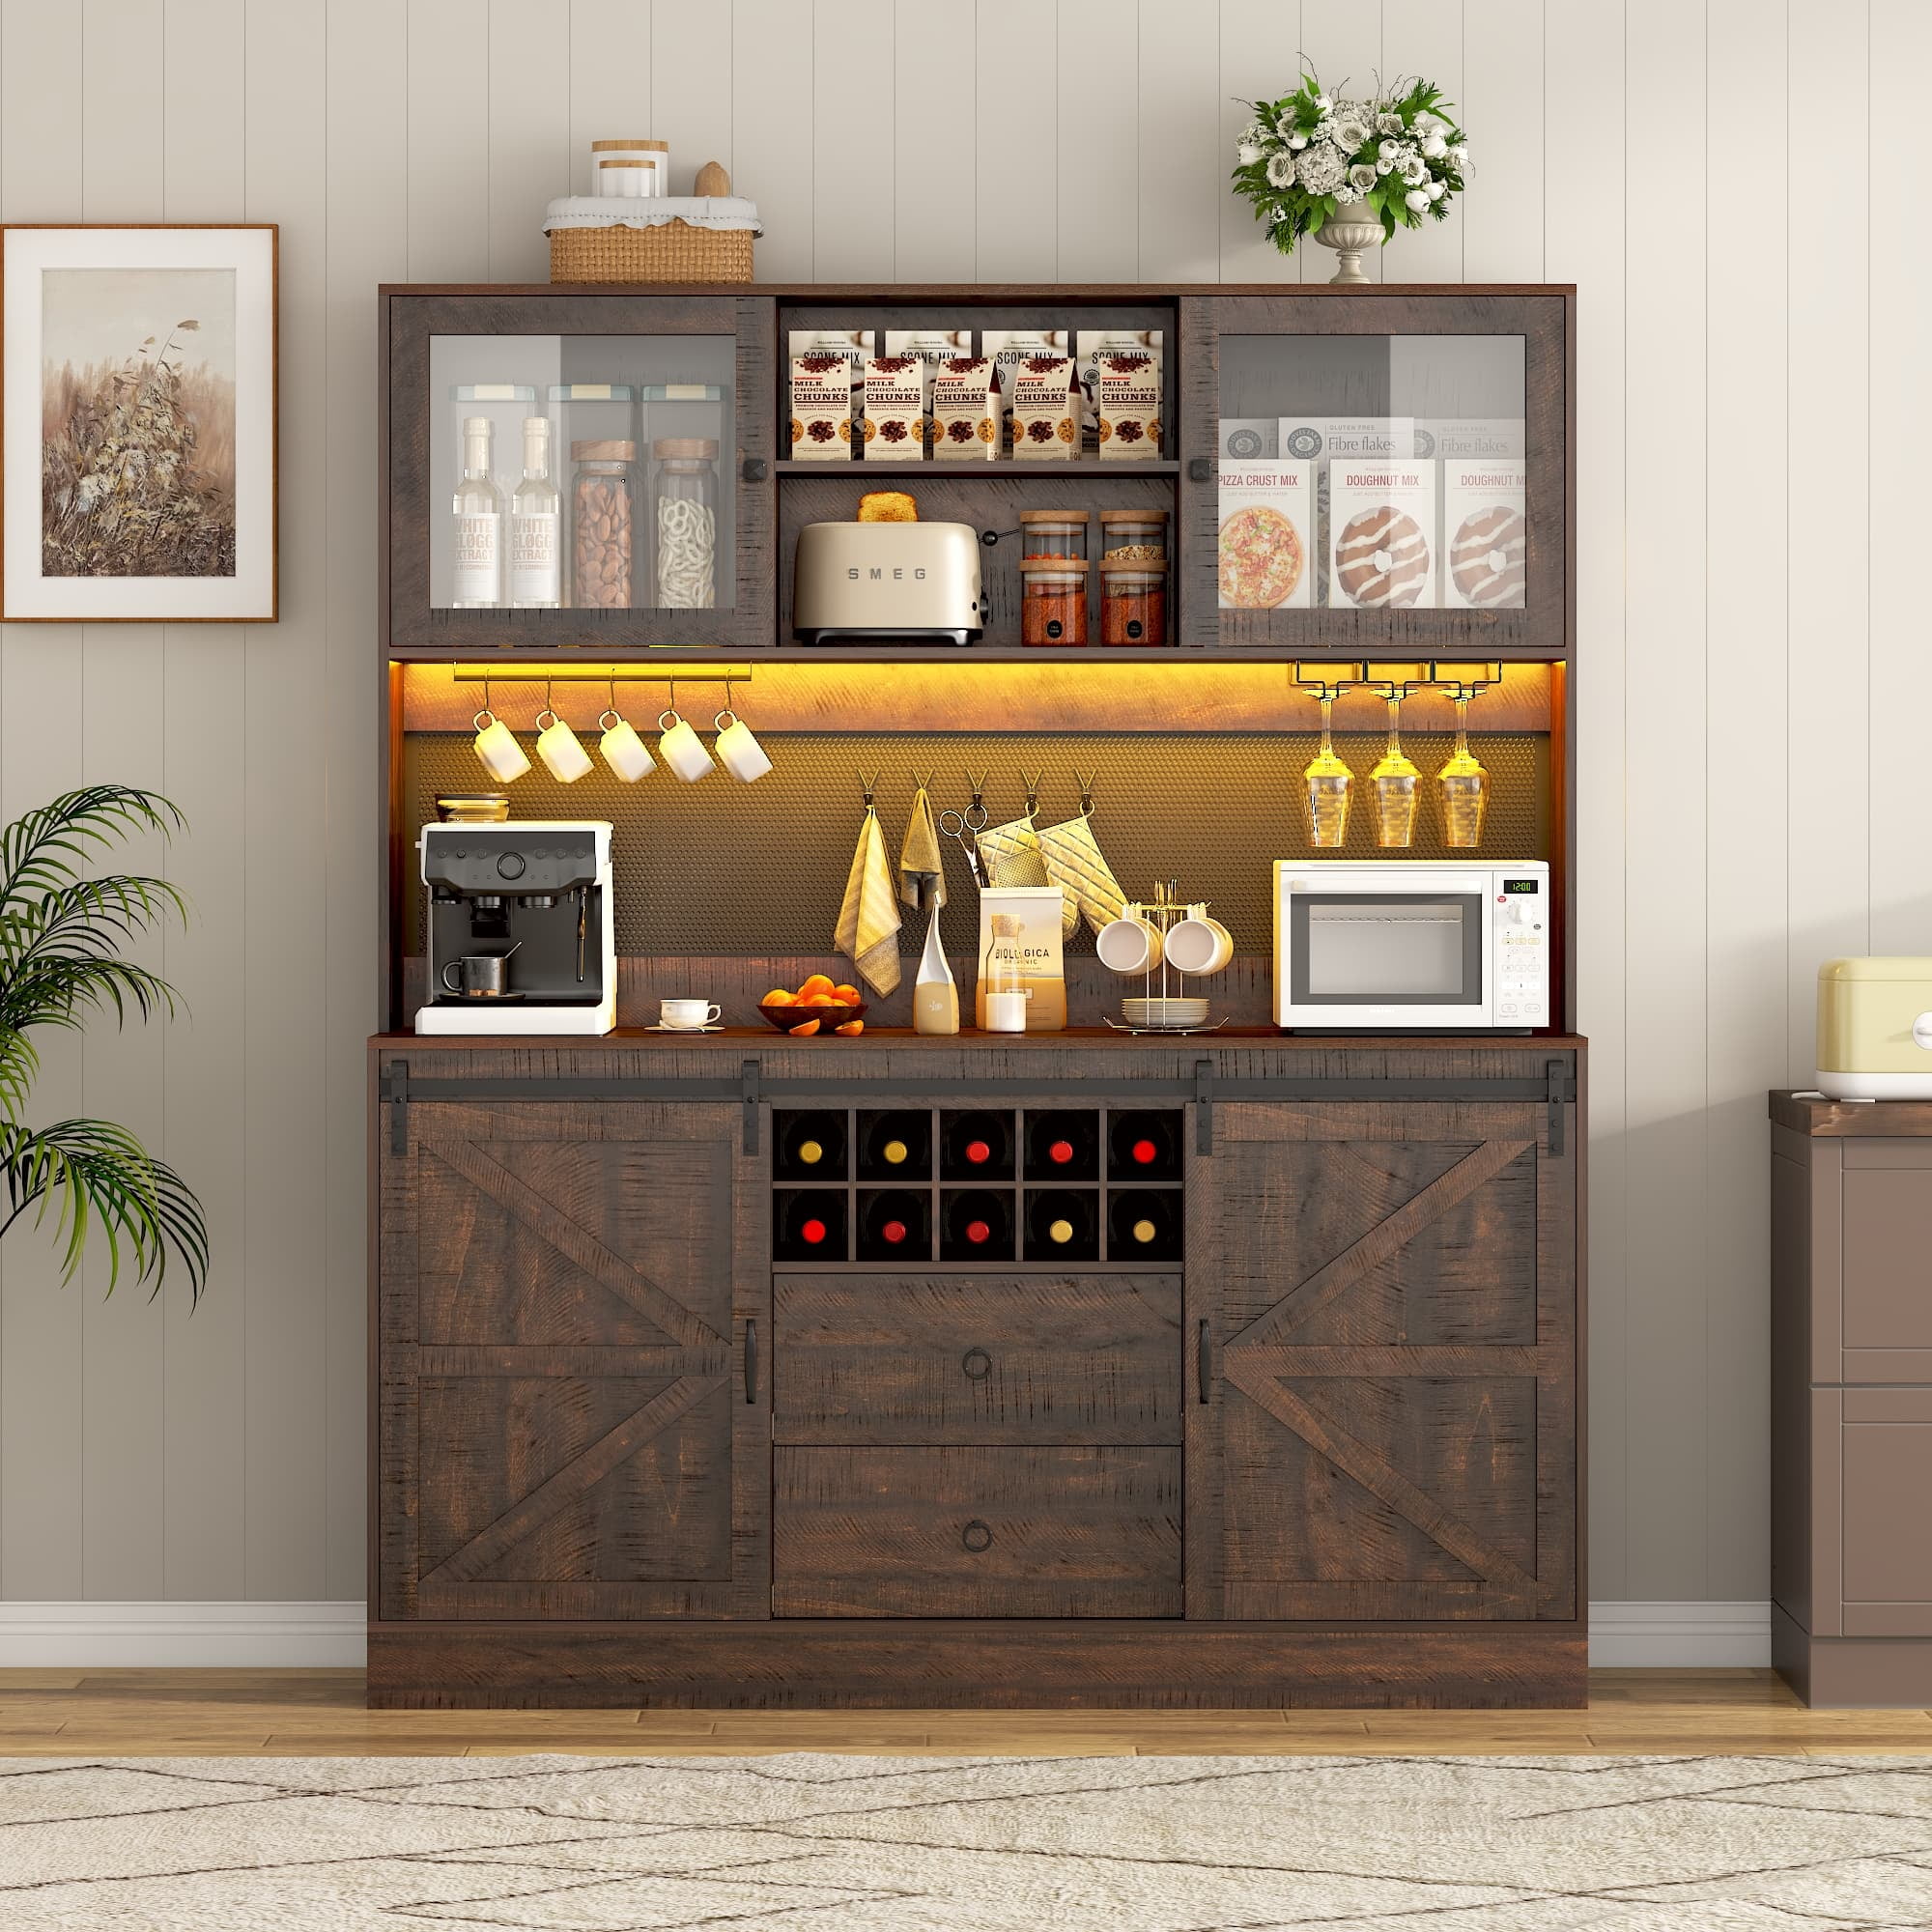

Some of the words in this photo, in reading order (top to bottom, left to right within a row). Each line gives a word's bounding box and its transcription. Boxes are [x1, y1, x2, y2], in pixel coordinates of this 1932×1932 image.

[1328, 436, 1358, 451] Fibre
[1362, 436, 1396, 451] flakes
[1441, 438, 1470, 452] Fibre
[1475, 438, 1508, 452] flakes
[1246, 474, 1277, 486] CRUST
[1280, 474, 1298, 486] MIX
[1347, 474, 1399, 486] DOUGHNUT
[1402, 474, 1419, 486] MIX
[1462, 474, 1513, 486] DOUGHNUT
[848, 568, 926, 580] SMEG
[1513, 882, 1531, 892] 12:00
